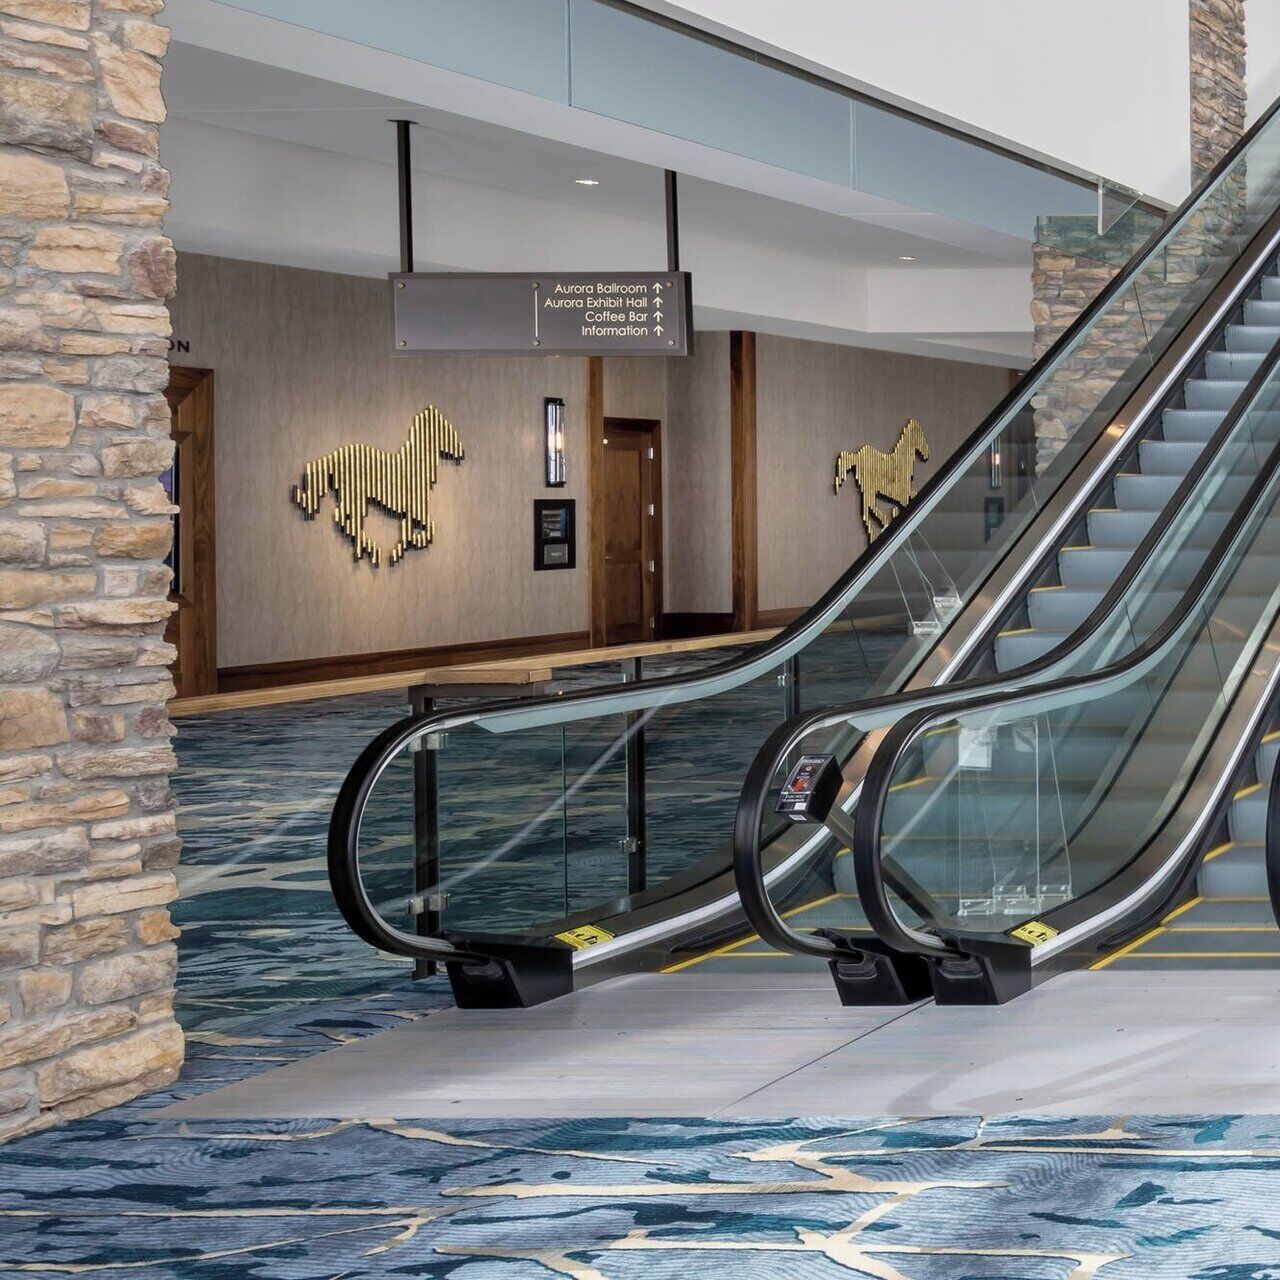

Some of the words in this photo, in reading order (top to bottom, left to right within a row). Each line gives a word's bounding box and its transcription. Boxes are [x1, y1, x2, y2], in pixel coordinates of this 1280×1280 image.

[555, 283, 594, 294] Aurora
[597, 283, 647, 294] Ballroom
[544, 297, 583, 308] Aurora
[587, 297, 622, 308] Exhibit
[626, 297, 648, 308] Hall
[585, 311, 626, 322] Coffee
[629, 311, 648, 322] Bar
[582, 325, 648, 336] Information
